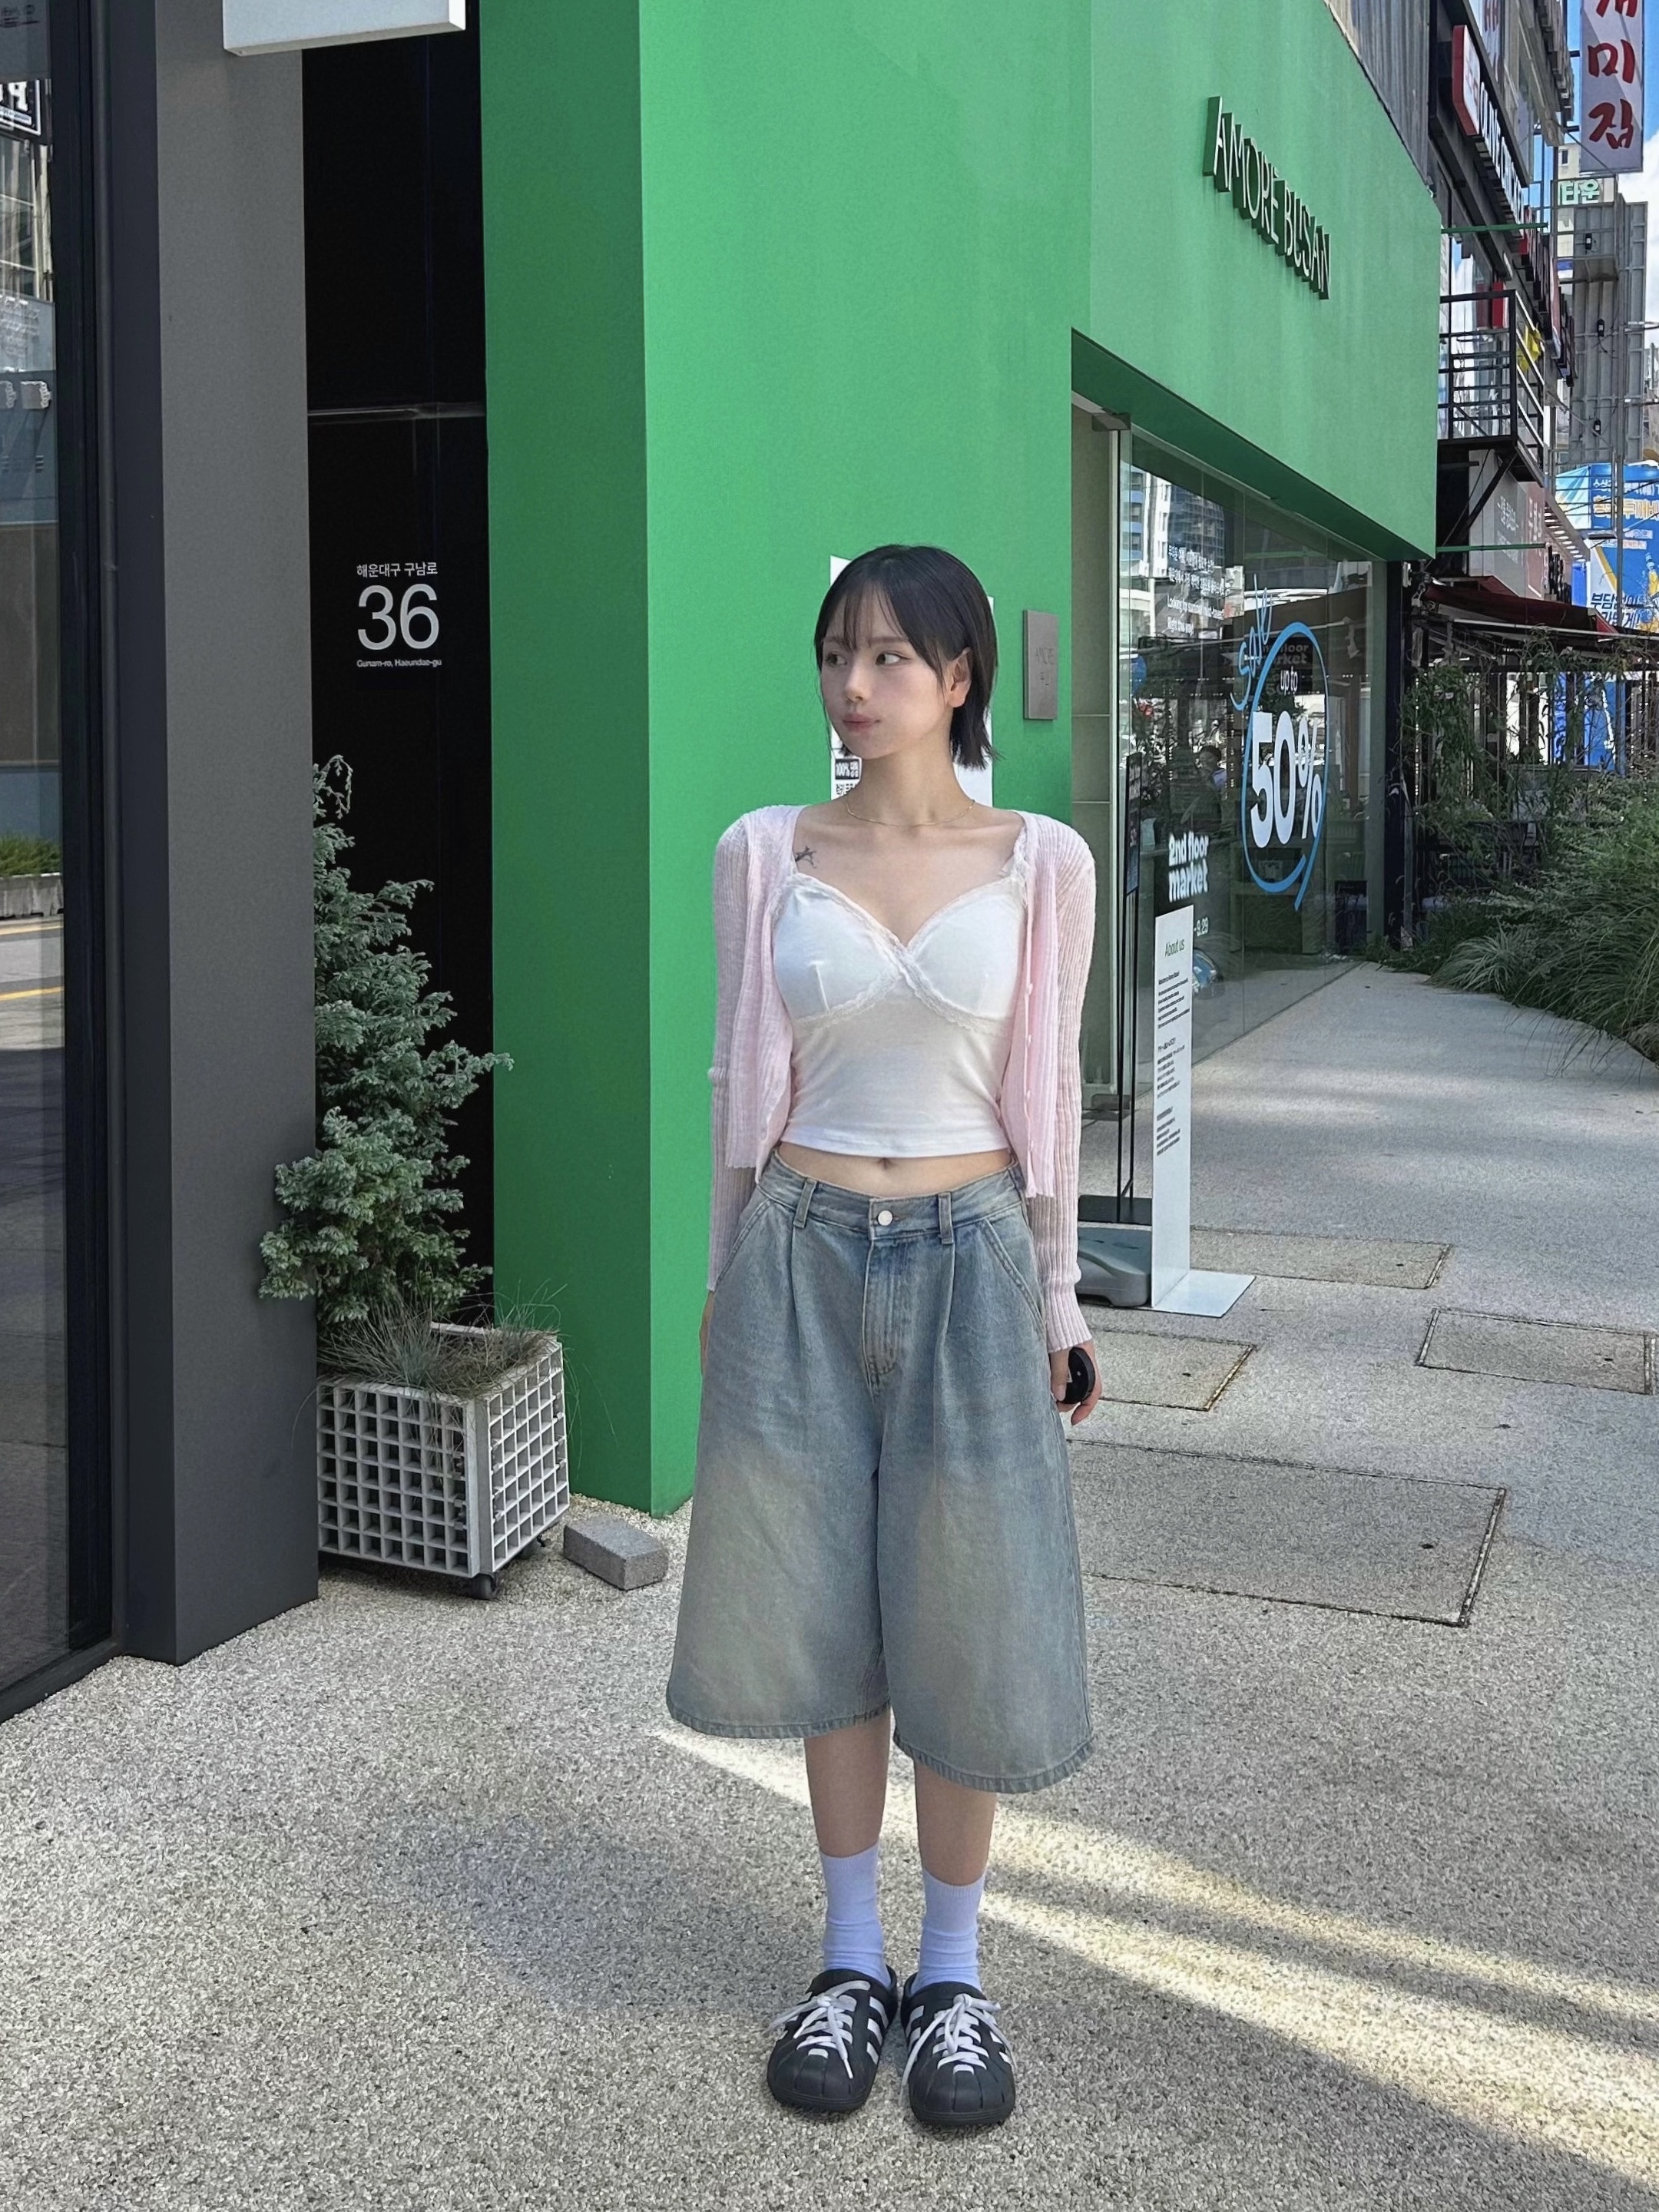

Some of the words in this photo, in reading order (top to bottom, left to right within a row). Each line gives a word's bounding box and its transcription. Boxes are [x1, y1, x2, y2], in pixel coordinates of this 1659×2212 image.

[1203, 96, 1280, 244] AMORE
[1276, 179, 1330, 300] BUSAN
[356, 563, 401, 578] 해운대구
[404, 561, 438, 577] 구남로
[357, 583, 439, 651] 36
[1280, 669, 1290, 696] up
[1290, 665, 1298, 692] to
[1250, 710, 1322, 848] 50%
[1168, 832, 1187, 866] 2nd
[1188, 830, 1209, 861] floor
[1168, 858, 1208, 902] market
[1164, 939, 1179, 958] About
